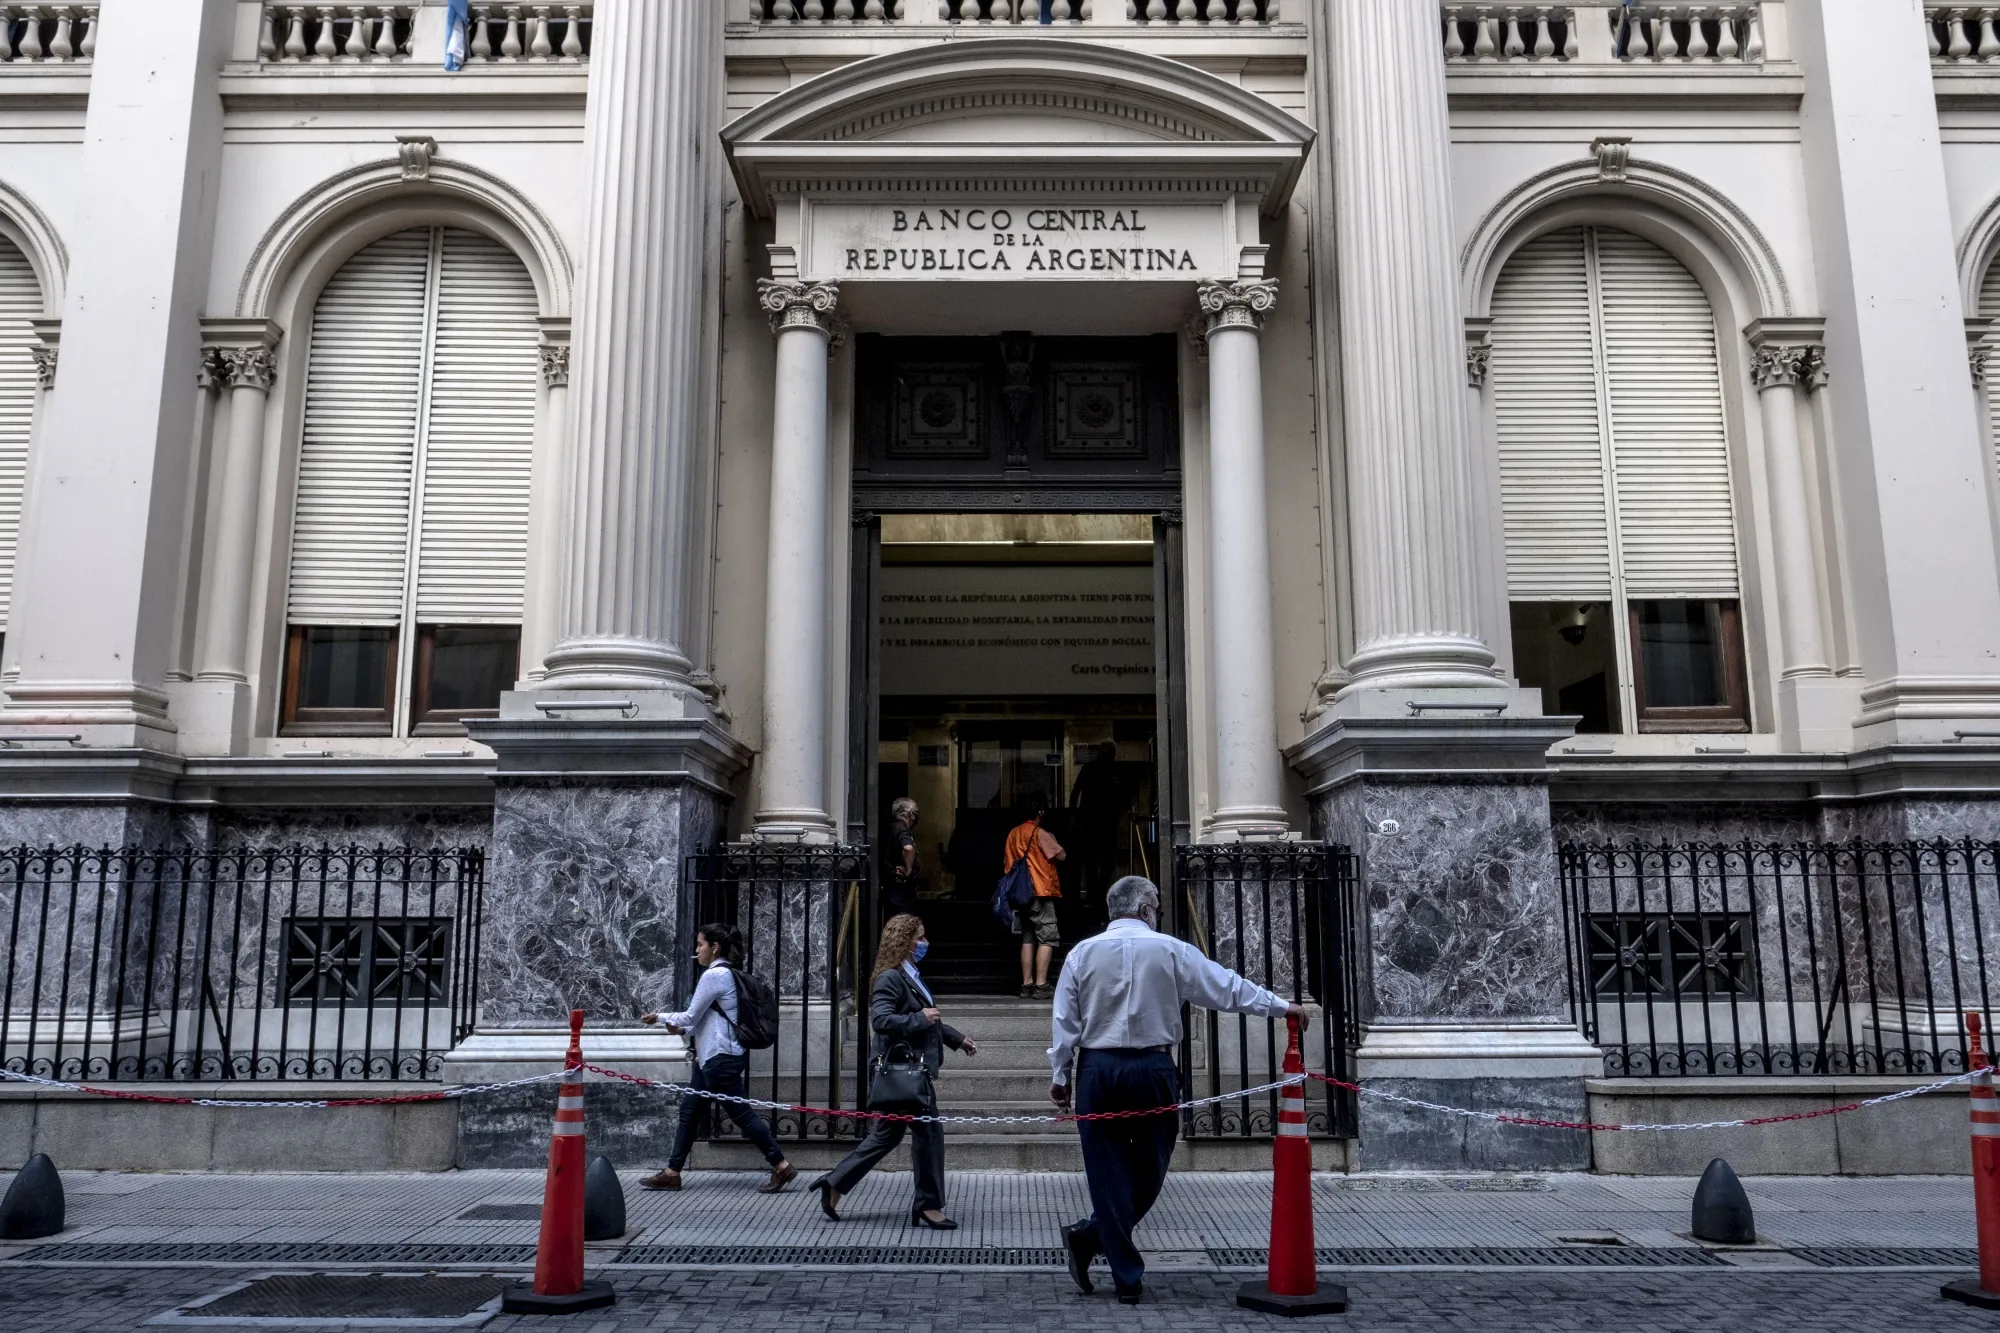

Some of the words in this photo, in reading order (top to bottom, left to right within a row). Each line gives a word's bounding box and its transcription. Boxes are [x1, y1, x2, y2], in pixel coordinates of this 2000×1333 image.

[892, 209, 1012, 232] BANCO
[1027, 209, 1147, 232] CENTRAL
[993, 233, 1016, 247] DE
[1022, 233, 1044, 247] LA
[845, 248, 1011, 270] REPUBLICA
[1026, 248, 1197, 270] ARGENTINA
[881, 594, 926, 602] CENTRAL
[929, 594, 943, 602] DE
[961, 592, 1017, 602] REPÚBLICA
[1019, 594, 1077, 602] ARGENTINA
[1080, 594, 1109, 602] TIENE
[1111, 594, 1132, 602] POR
[888, 617, 901, 625] LA
[903, 616, 970, 625] ESTABILIDAD
[972, 616, 1034, 625] MONETARIA,
[1037, 616, 1049, 624] LA
[1052, 616, 1118, 624] ESTABILIDAD
[887, 638, 894, 646] Y
[896, 638, 907, 647] EL
[910, 638, 975, 647] DESARROLLO
[977, 637, 1038, 647] ECONÓMICO
[1040, 638, 1060, 646] CON
[1063, 638, 1109, 647] EQUIDAD
[1111, 637, 1151, 646] SOCIAL.
[1071, 664, 1100, 674] Carta
[1102, 664, 1149, 676] Orgánica
[1383, 823, 1396, 832] 266
